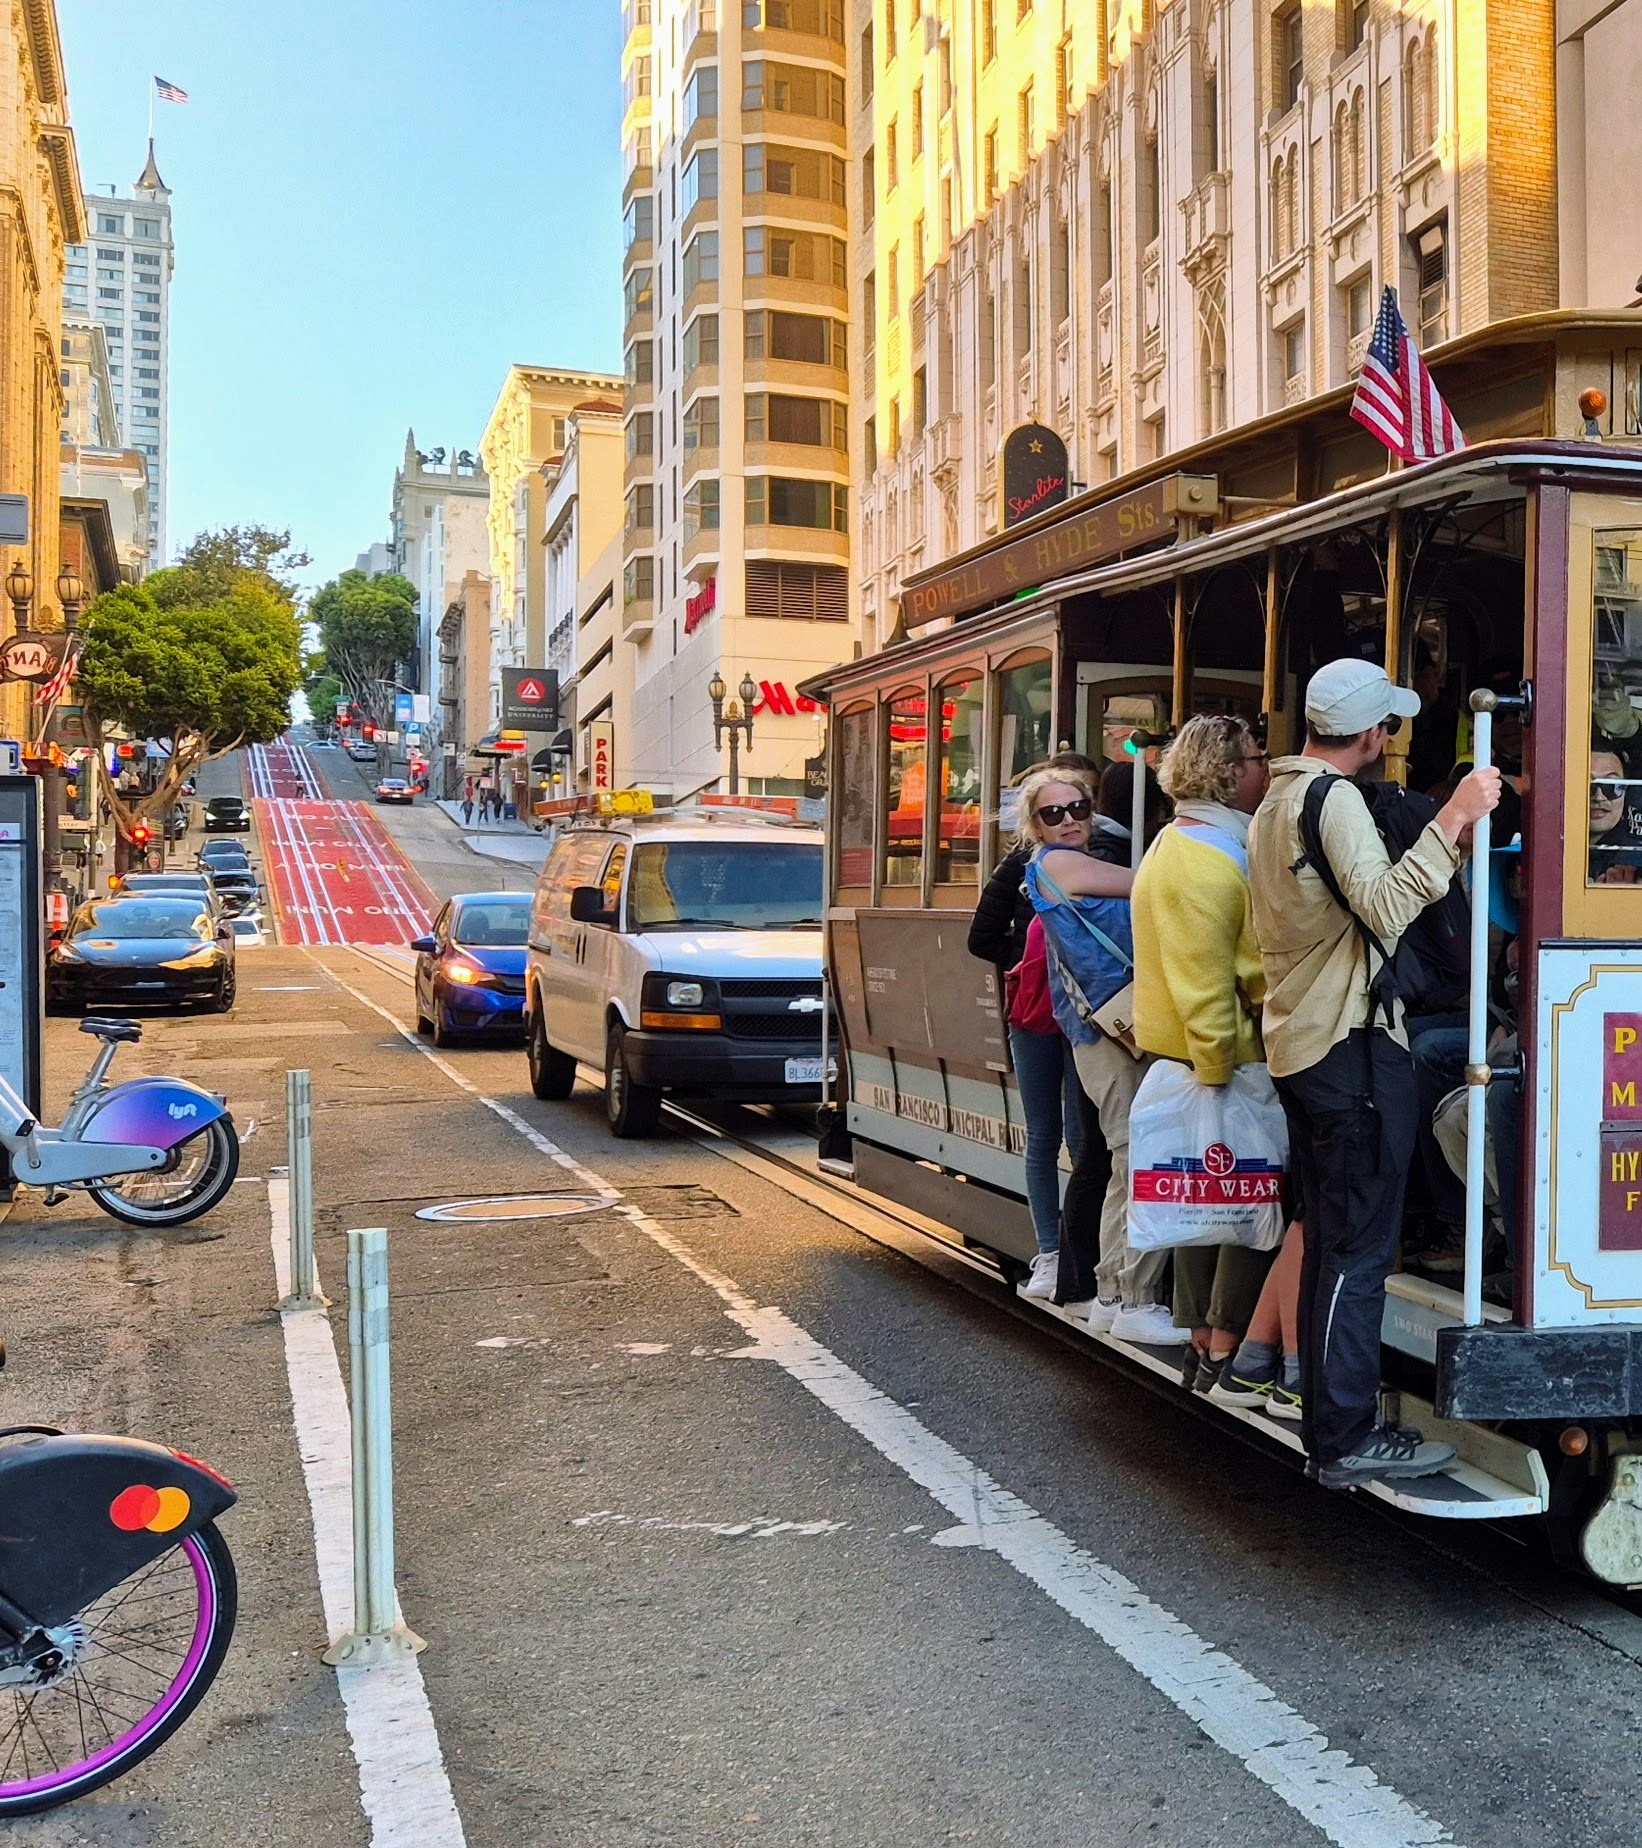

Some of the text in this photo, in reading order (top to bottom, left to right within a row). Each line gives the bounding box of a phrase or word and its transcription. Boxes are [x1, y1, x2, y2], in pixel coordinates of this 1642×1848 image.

[1008, 475, 1064, 520] Starlite
[911, 501, 1161, 618] POWELL & HYDE Sts.
[595, 738, 608, 787] PARK
[874, 1086, 890, 1110] SAN
[1208, 1147, 1230, 1172] SF
[1155, 1178, 1281, 1197] CITY WEAR
